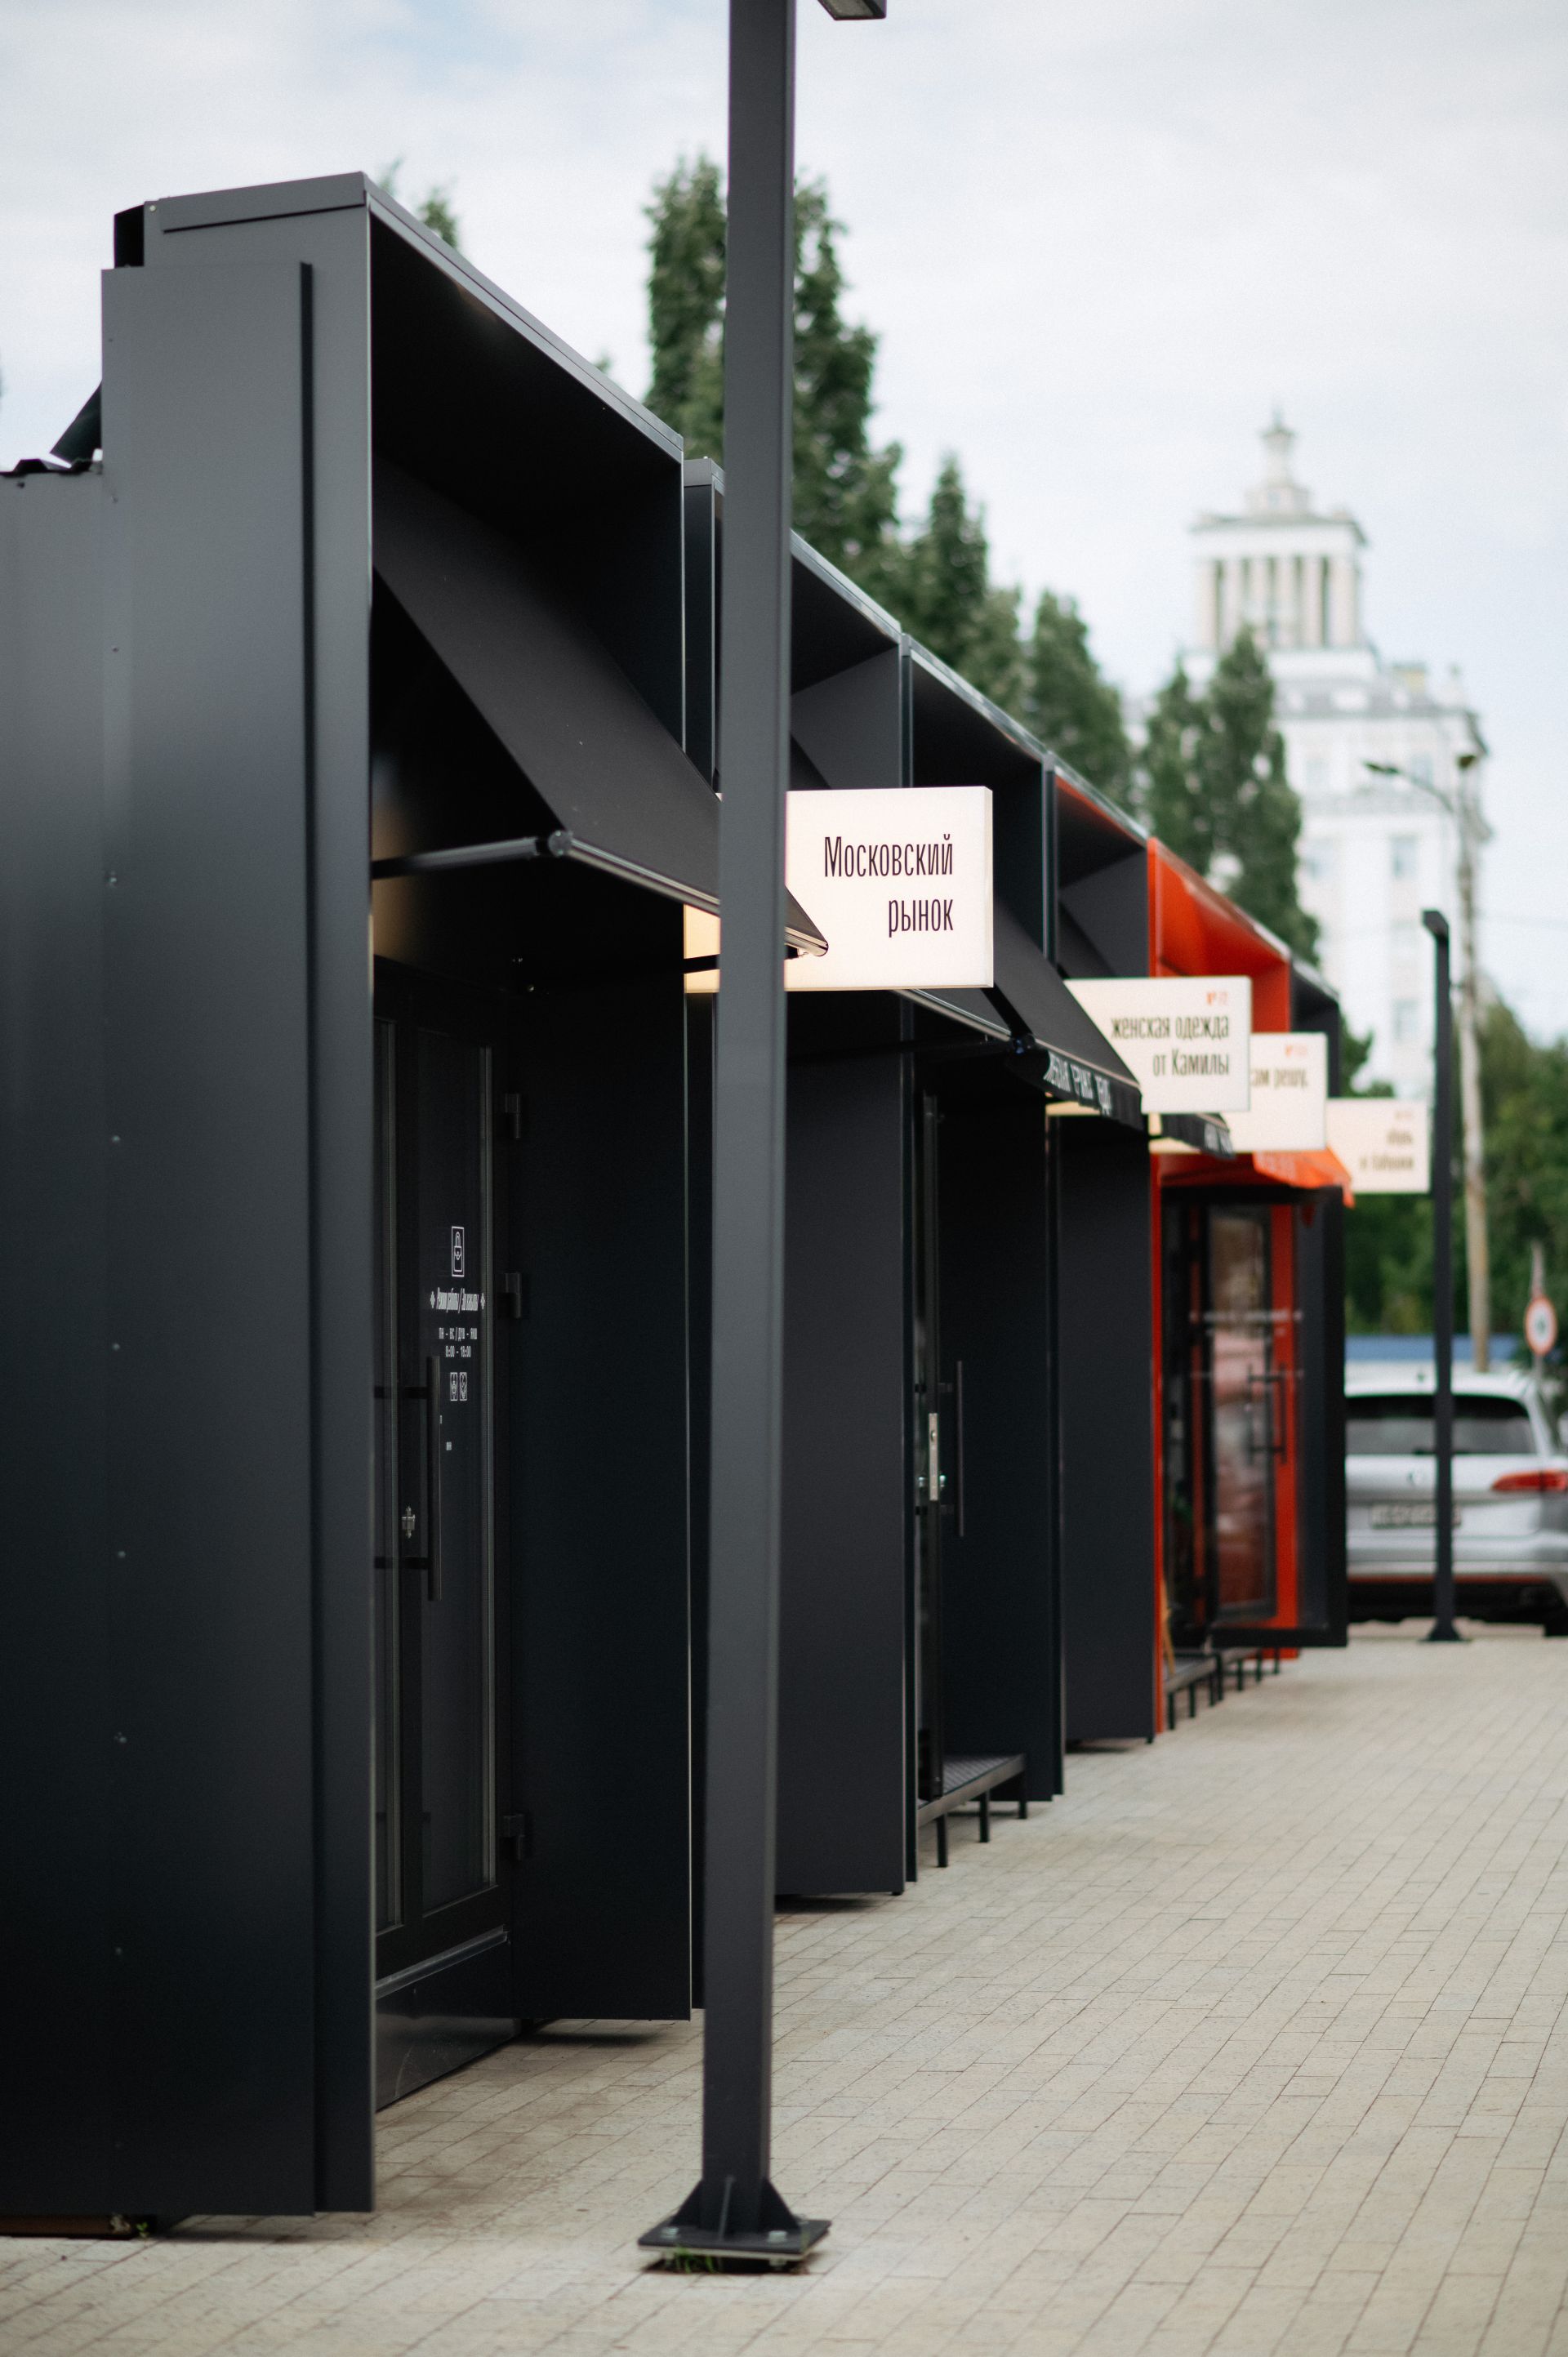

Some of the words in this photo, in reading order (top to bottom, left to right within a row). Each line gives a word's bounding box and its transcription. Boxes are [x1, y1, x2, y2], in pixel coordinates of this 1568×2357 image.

[824, 833, 953, 877] Московский
[889, 899, 954, 938] рынок
[1111, 1017, 1170, 1039] женская
[1175, 1015, 1229, 1040] одежда
[1152, 1053, 1167, 1076] от
[1171, 1049, 1230, 1076] Камилы
